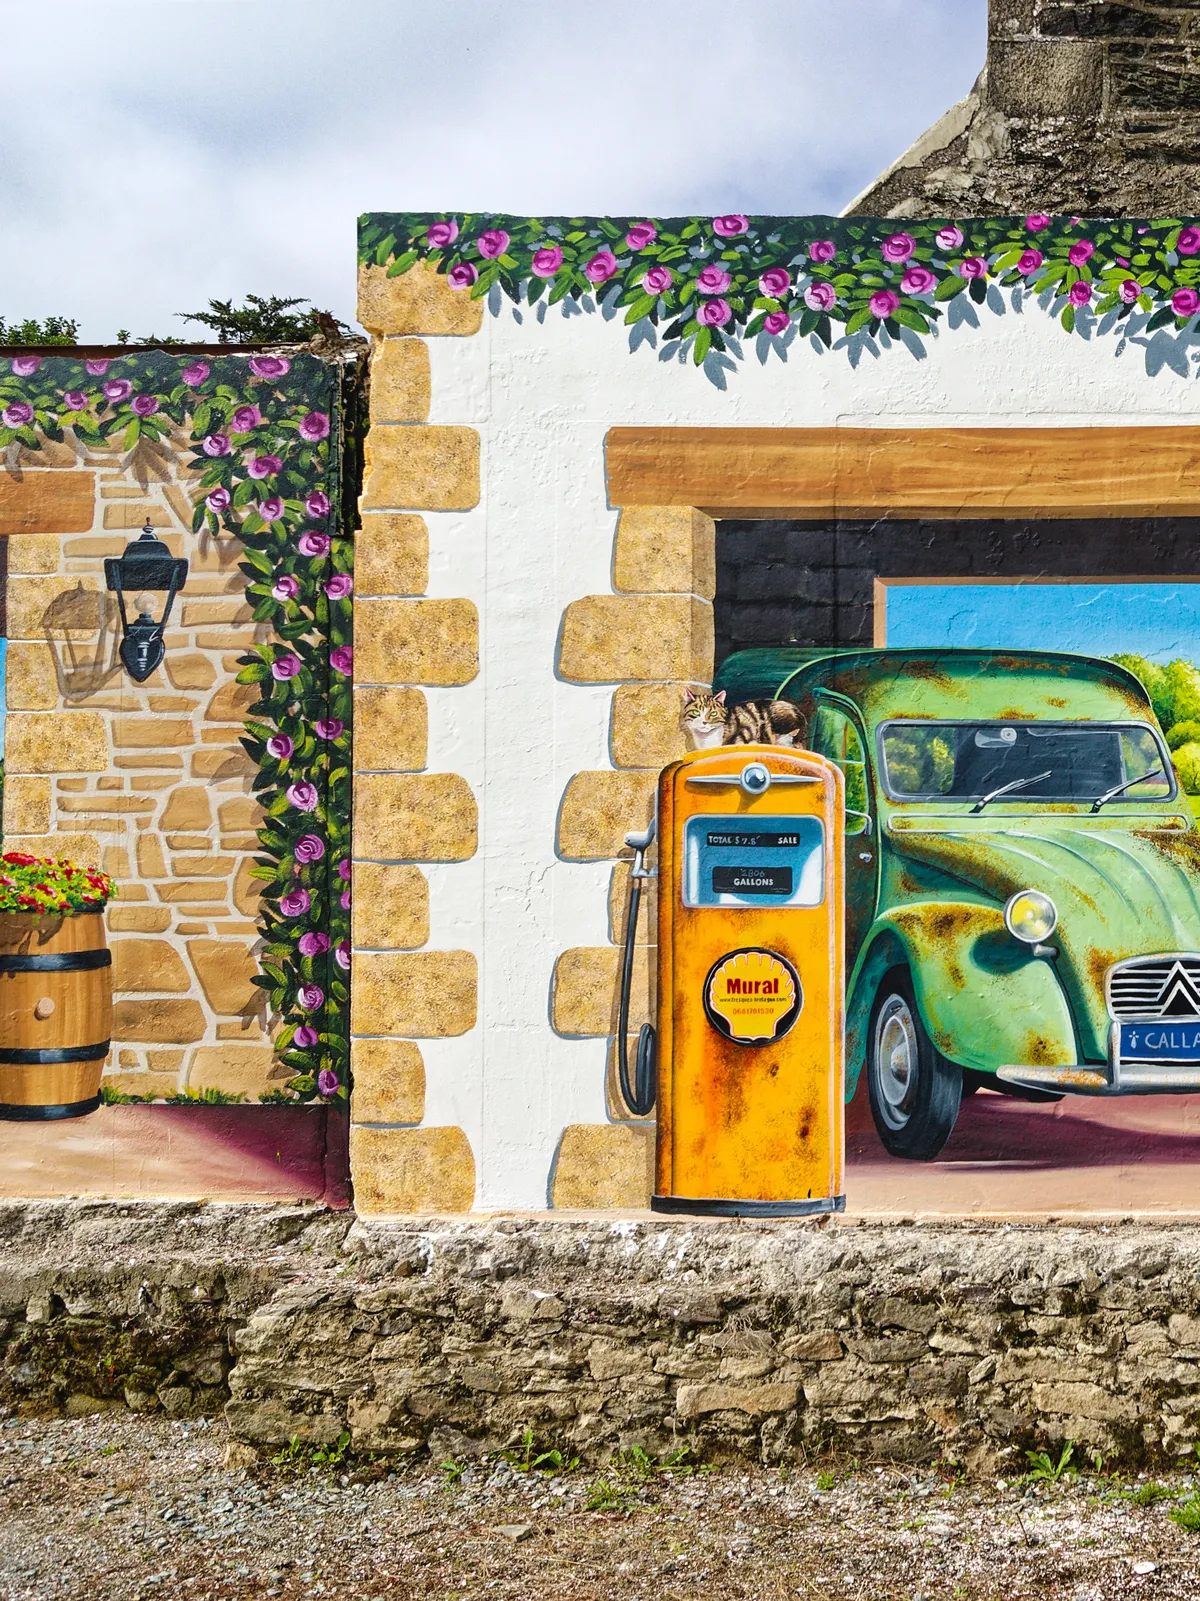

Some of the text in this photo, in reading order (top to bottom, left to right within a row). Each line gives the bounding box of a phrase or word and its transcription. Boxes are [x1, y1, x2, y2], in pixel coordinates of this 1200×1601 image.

[708, 835, 732, 844] TOTAL
[778, 836, 798, 845] SALE
[734, 878, 774, 887] GALLONS
[727, 978, 779, 995] Mural
